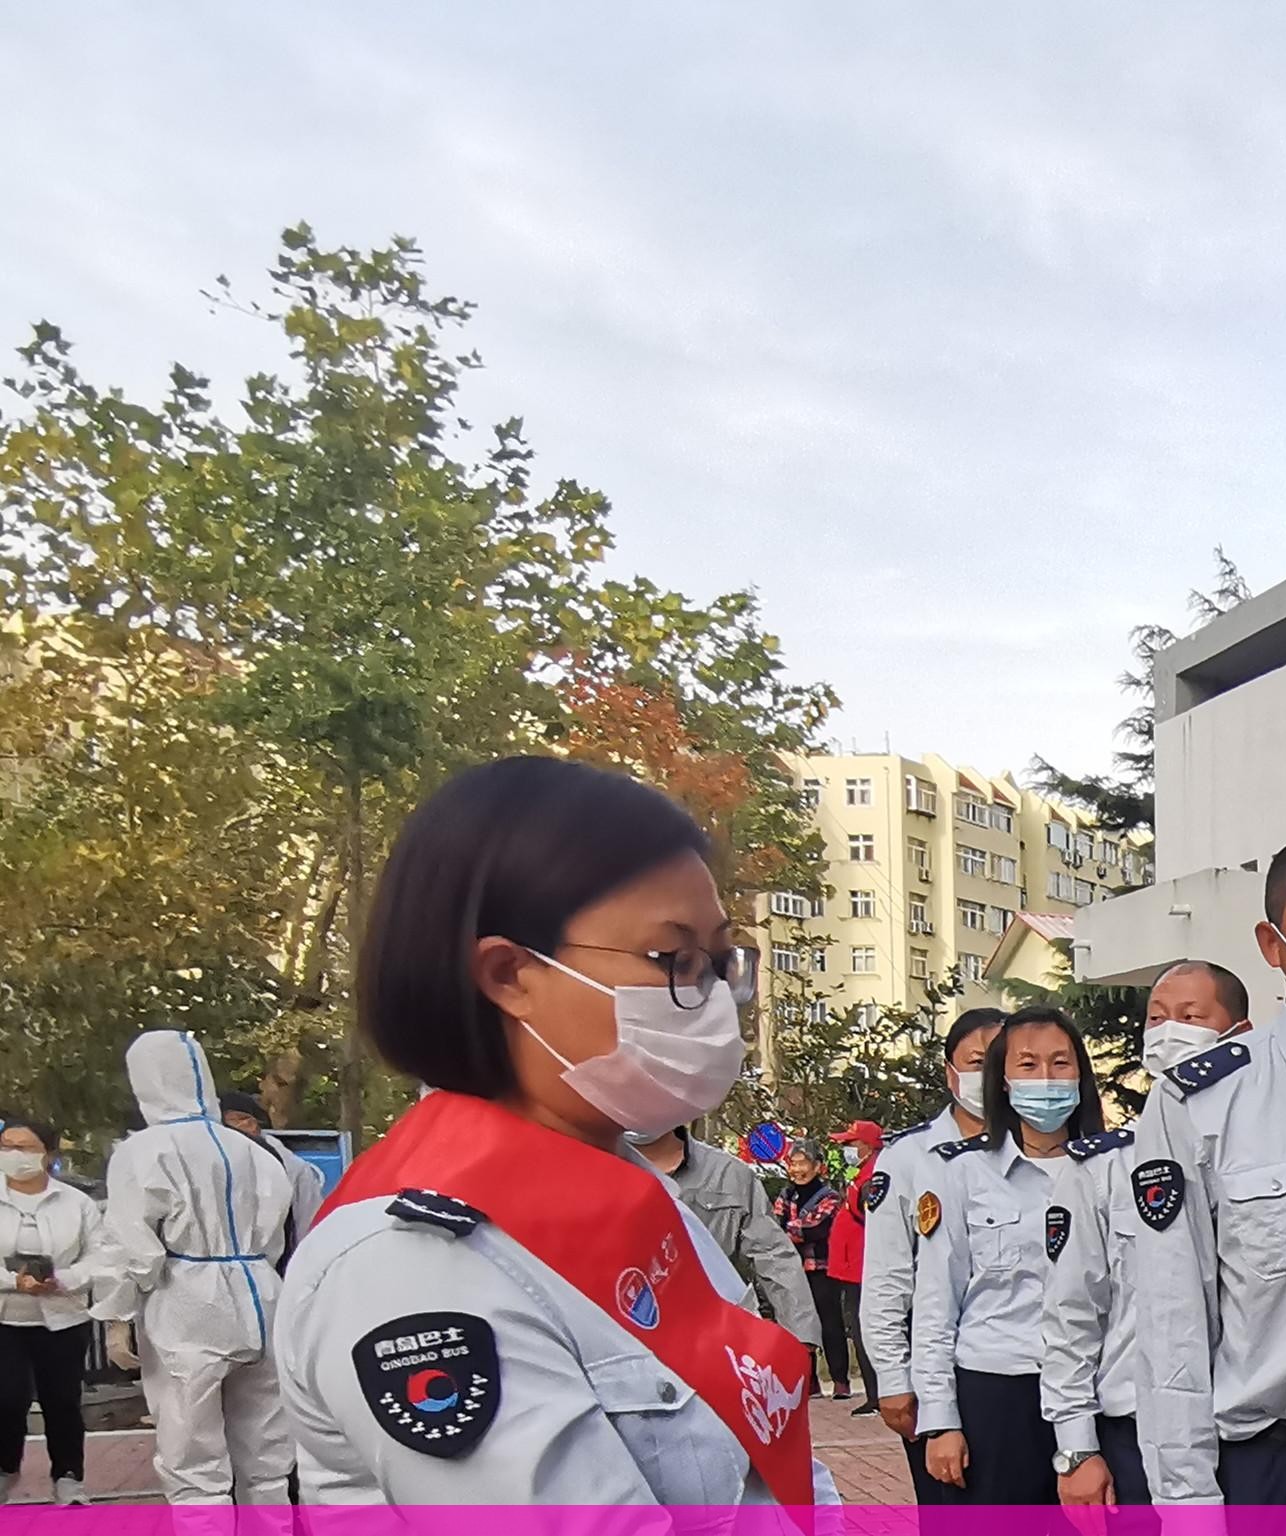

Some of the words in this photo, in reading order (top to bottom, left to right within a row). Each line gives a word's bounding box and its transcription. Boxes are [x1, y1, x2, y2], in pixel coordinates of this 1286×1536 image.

[374, 1327, 464, 1358] 青岛巴士
[441, 1345, 470, 1358] BUS
